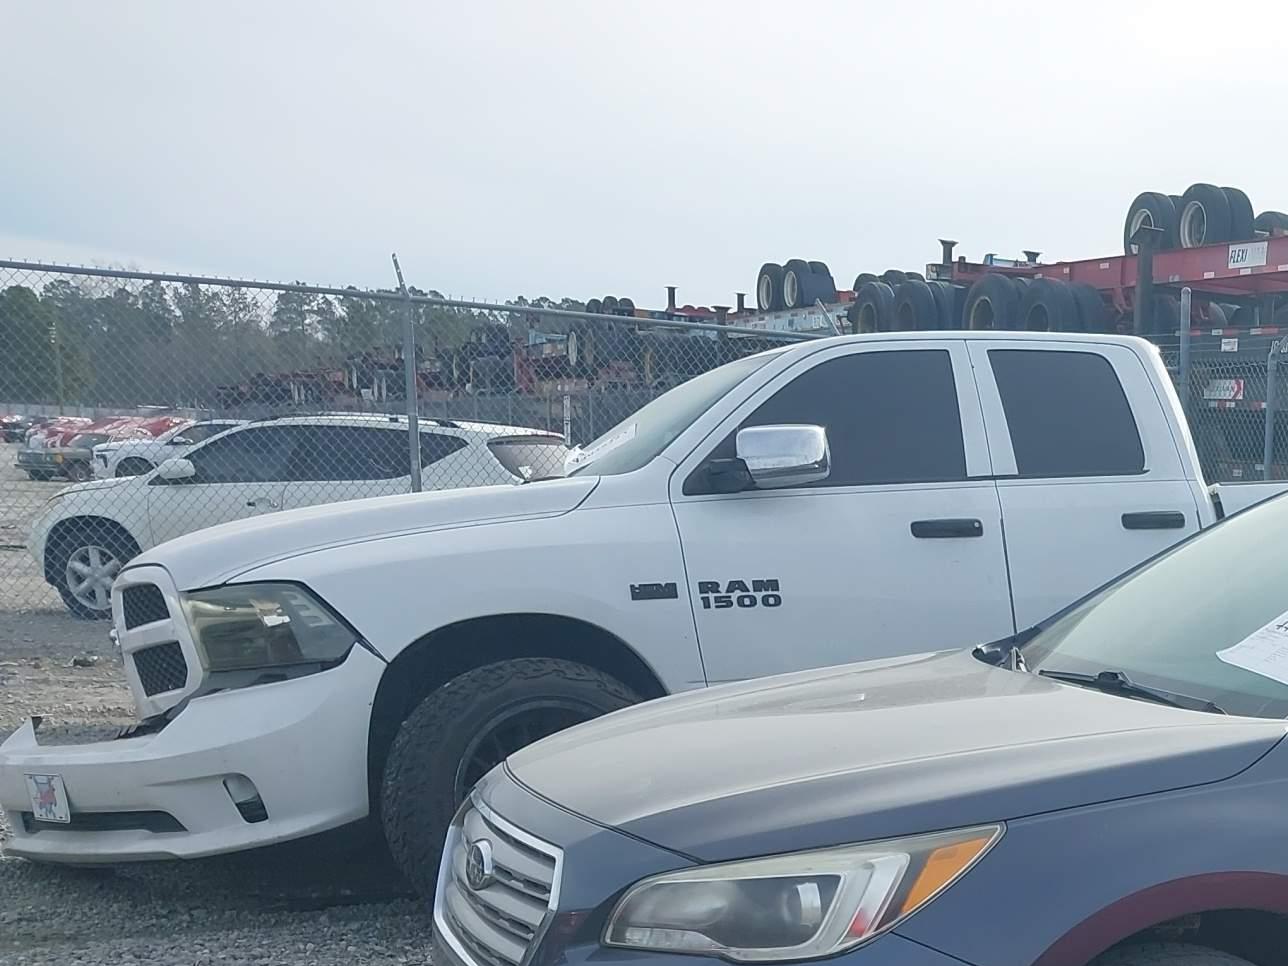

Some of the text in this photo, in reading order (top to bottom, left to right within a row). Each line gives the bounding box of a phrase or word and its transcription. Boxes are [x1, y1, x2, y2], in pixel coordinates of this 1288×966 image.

[1229, 248, 1249, 264] FLEXI
[698, 579, 780, 594] RAM
[700, 594, 782, 609] 1500
